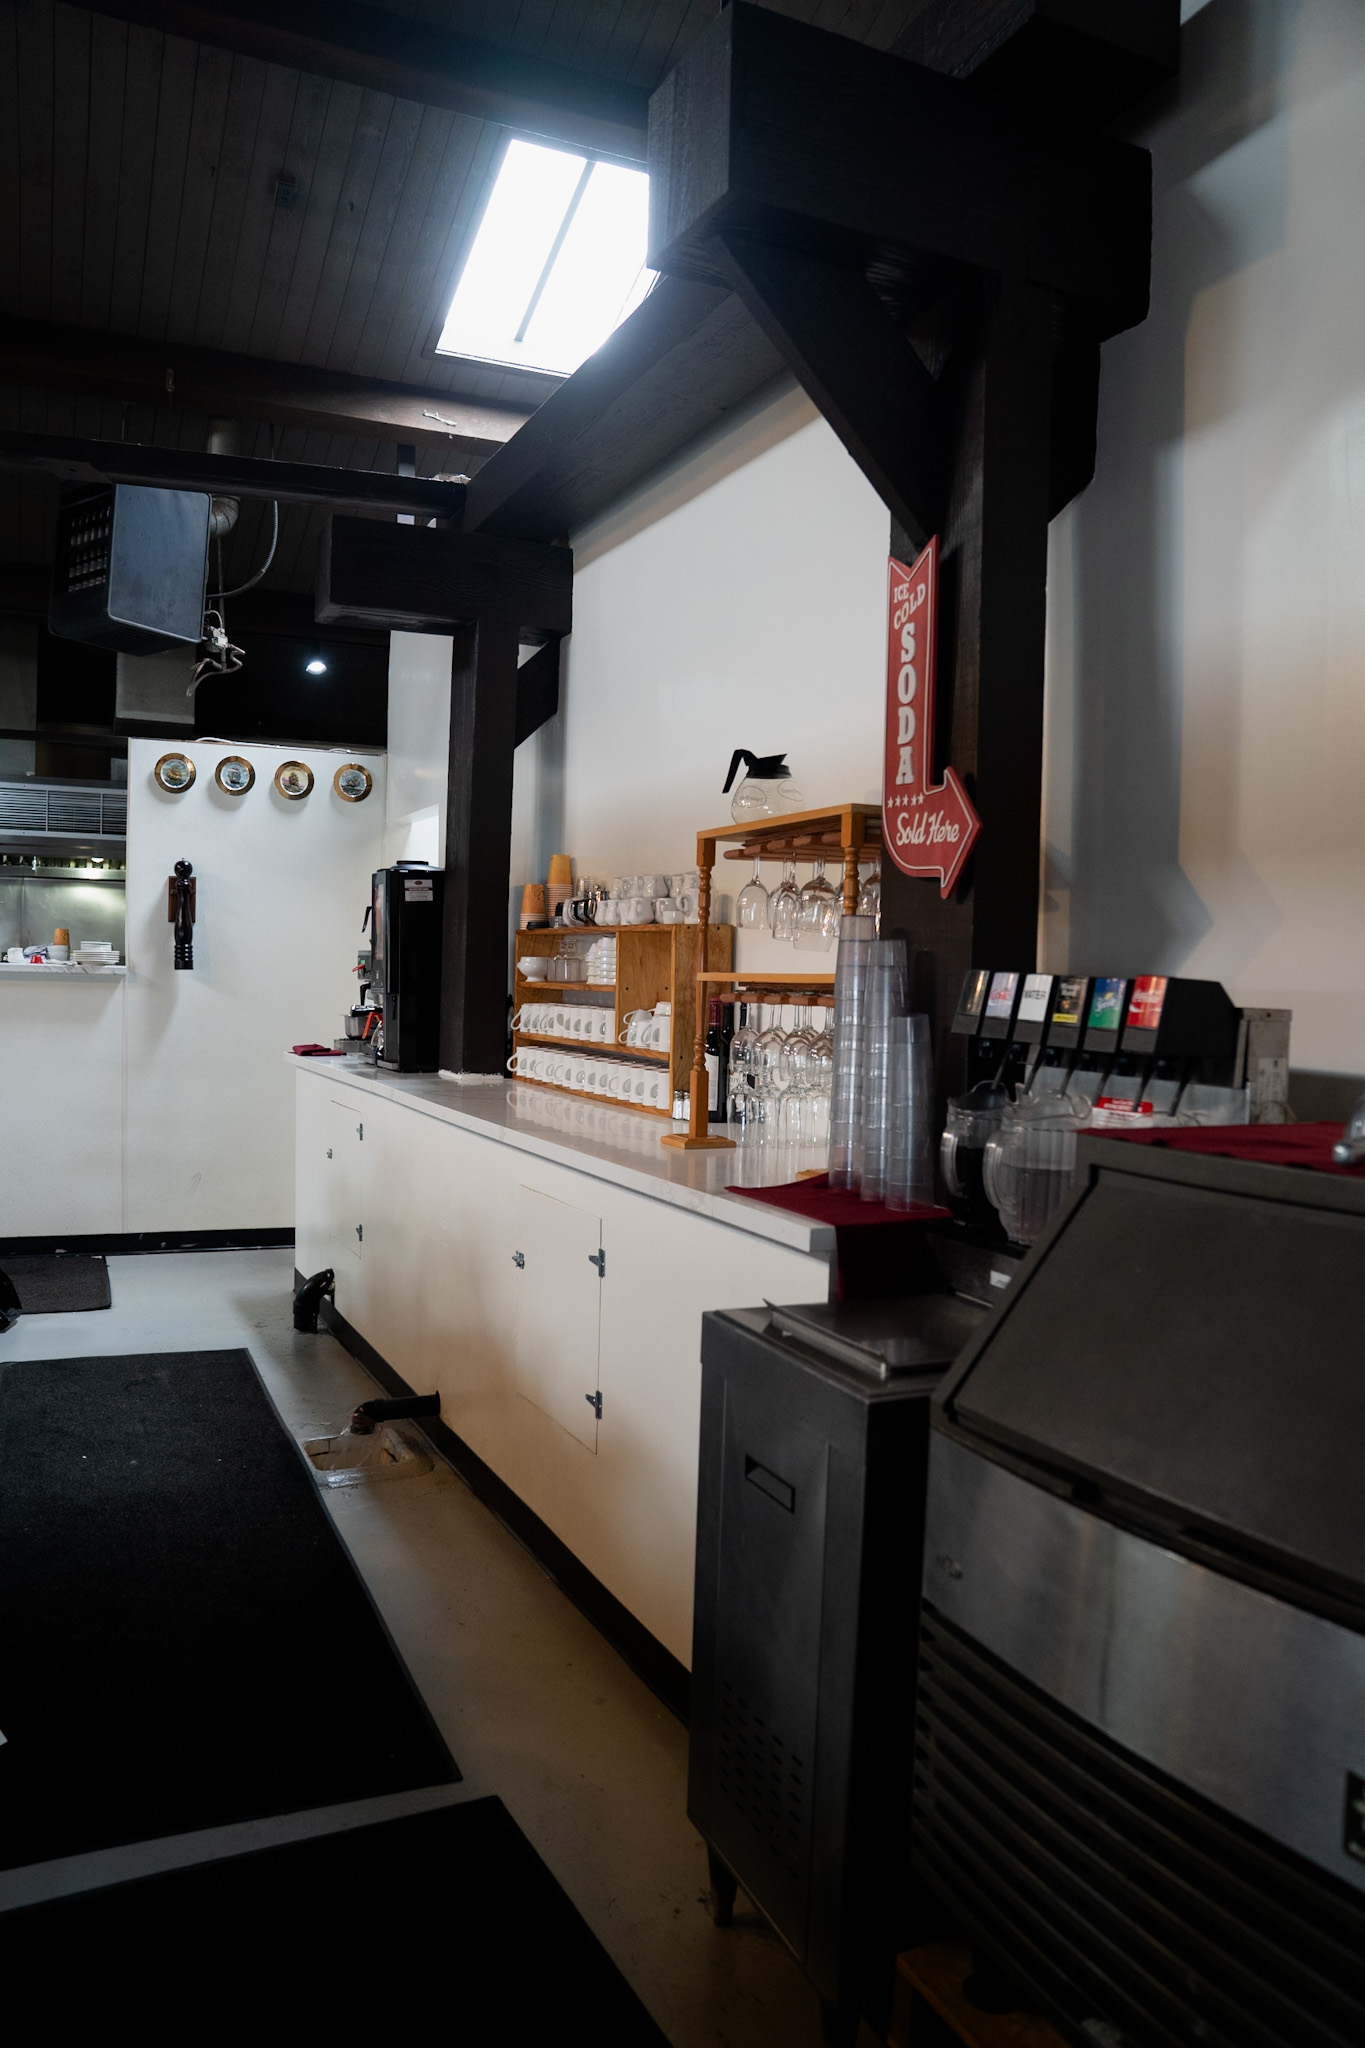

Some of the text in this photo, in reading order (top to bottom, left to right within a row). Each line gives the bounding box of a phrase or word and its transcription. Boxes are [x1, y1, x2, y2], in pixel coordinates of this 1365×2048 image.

[893, 583, 909, 604] ICE
[893, 583, 926, 630] COLD
[896, 622, 917, 786] SODA
[896, 810, 960, 846] Sold Here
[1024, 989, 1047, 1000] WATER
